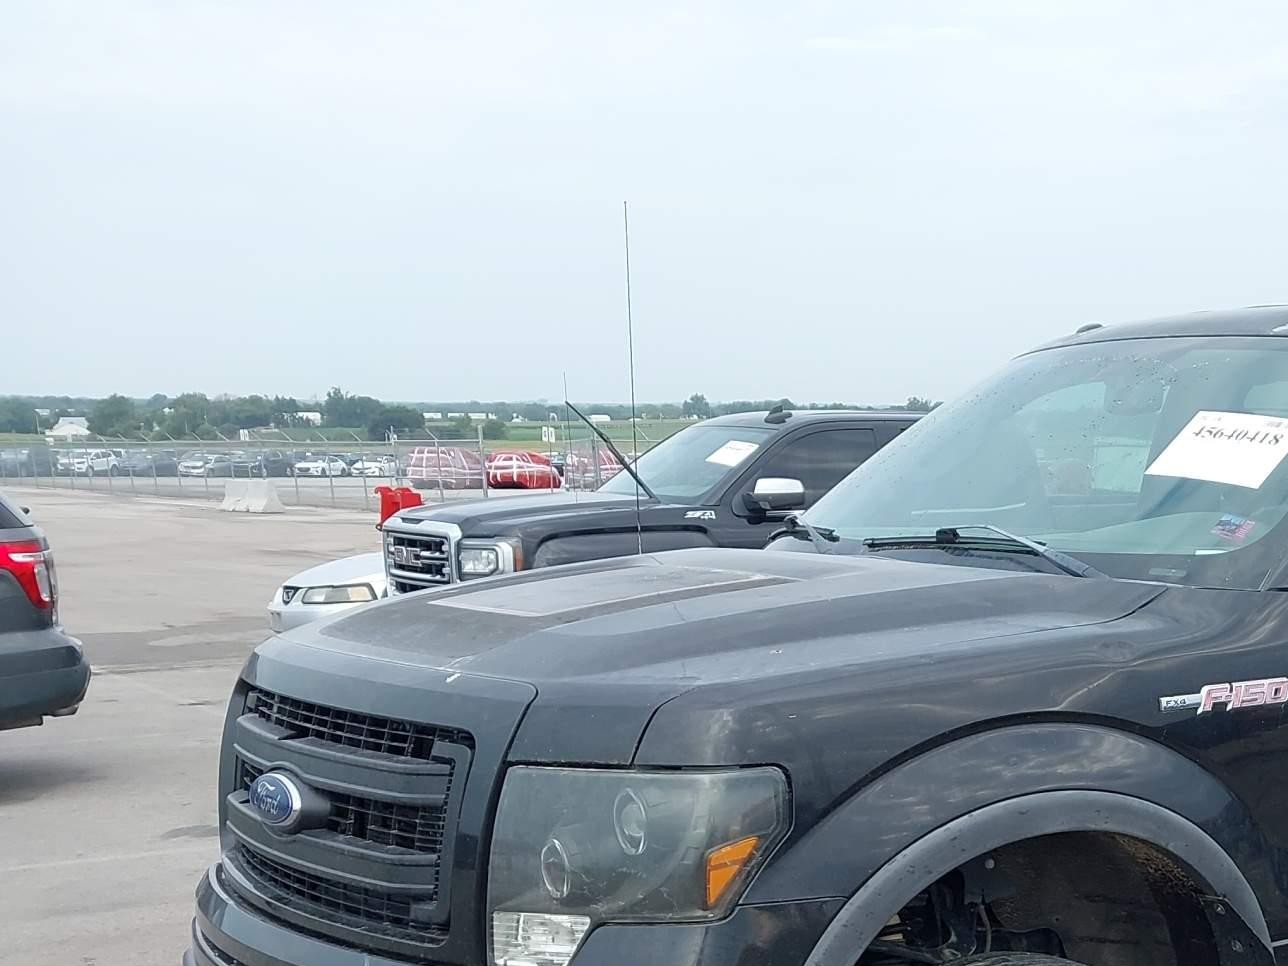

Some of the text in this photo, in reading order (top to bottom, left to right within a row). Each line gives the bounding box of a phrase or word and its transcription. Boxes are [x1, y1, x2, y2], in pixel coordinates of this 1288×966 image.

[1192, 425, 1284, 445] 45640418
[394, 545, 422, 567] GMC
[254, 781, 281, 815] Ford
